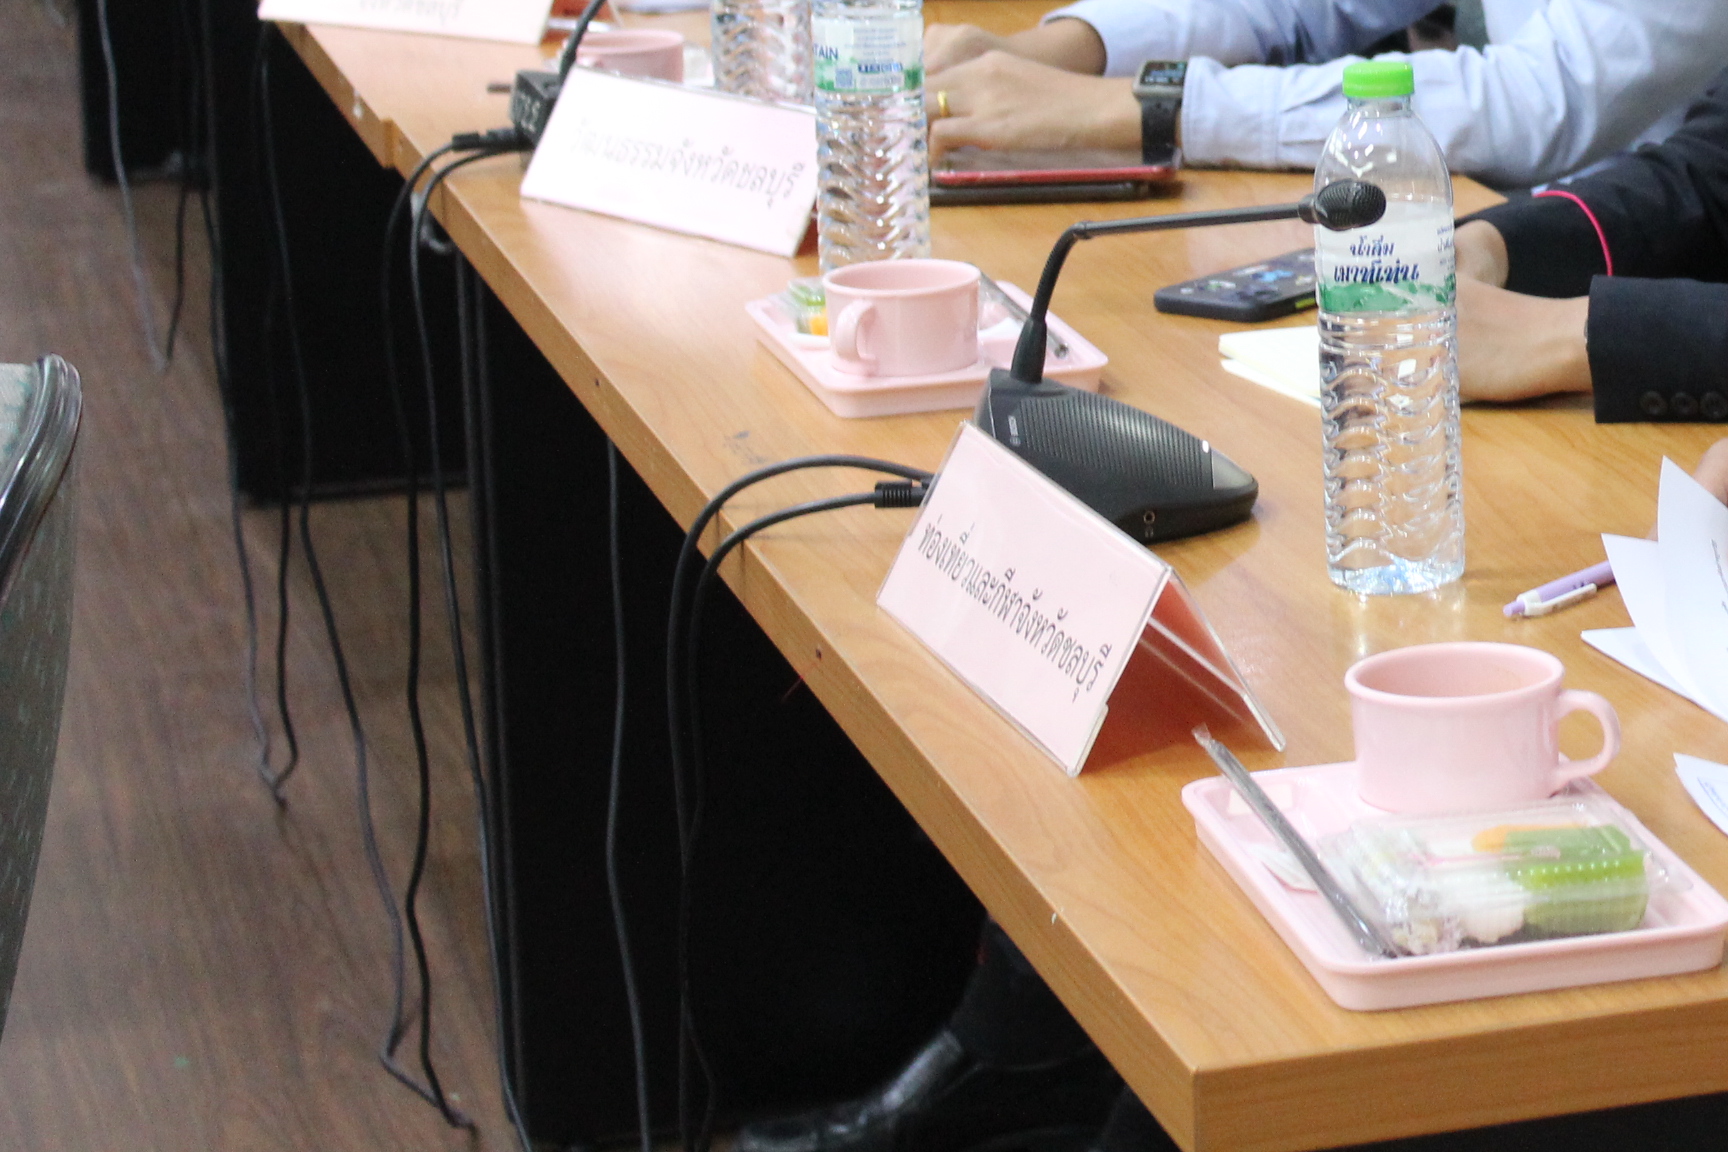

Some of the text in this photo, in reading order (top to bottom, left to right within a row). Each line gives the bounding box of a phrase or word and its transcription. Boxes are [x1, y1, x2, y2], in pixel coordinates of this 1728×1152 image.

[917, 513, 1113, 704] ท่องเที่ยวและกีฬาจังหวัดชลบุรี
